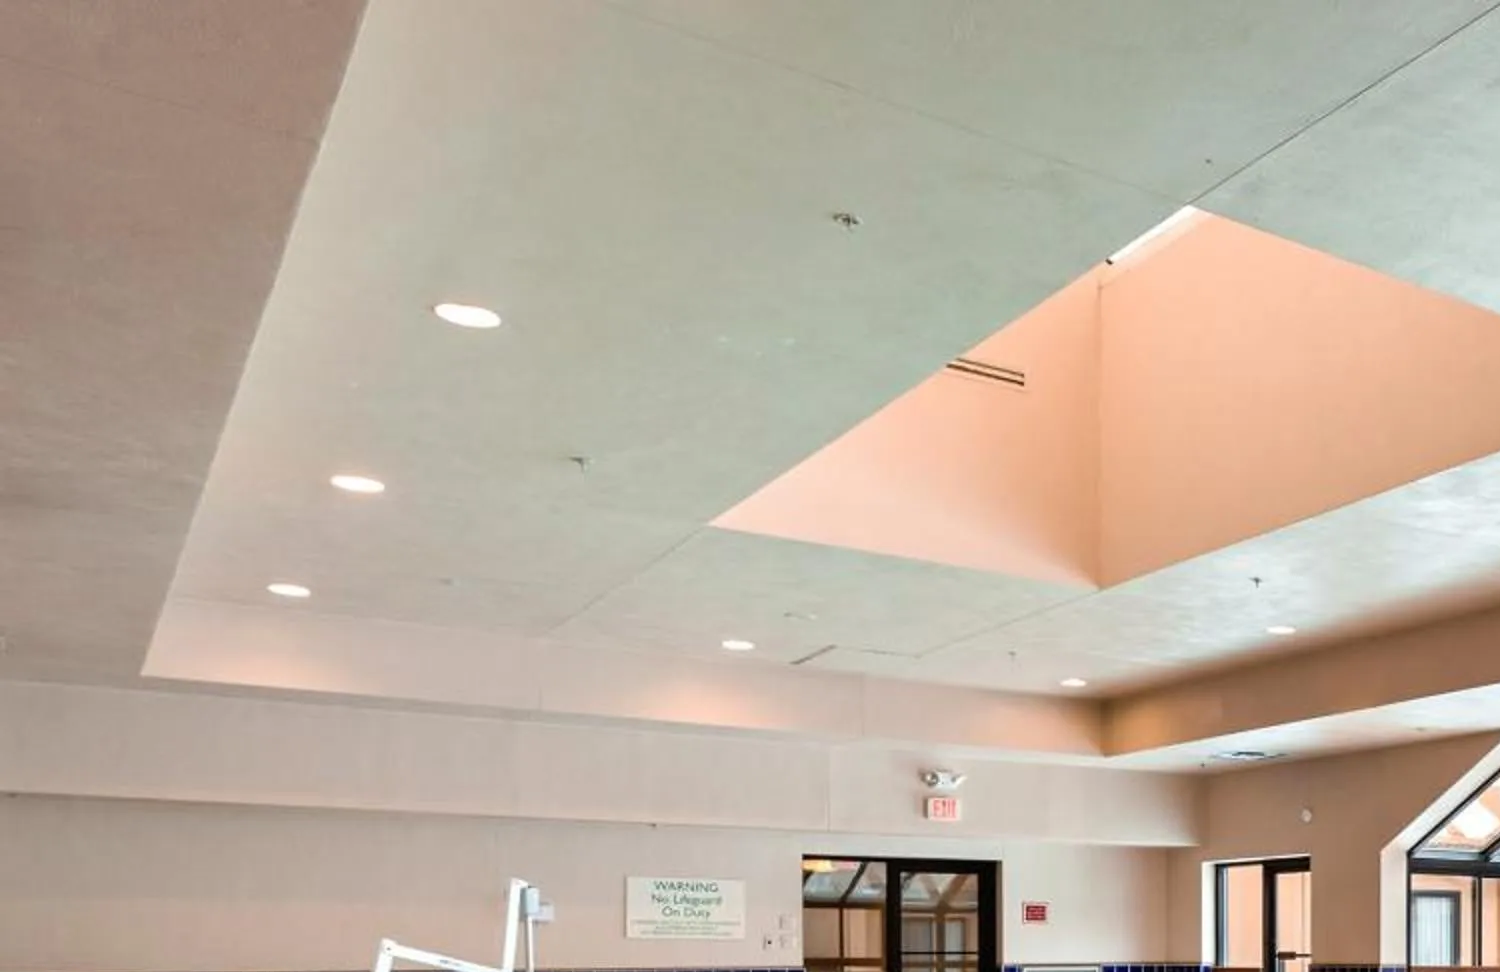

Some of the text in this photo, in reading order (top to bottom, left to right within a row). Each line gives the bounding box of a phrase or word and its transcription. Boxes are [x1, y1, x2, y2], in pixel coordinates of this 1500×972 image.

[933, 799, 956, 818] EXIT
[654, 880, 719, 893] WARNING
[651, 893, 723, 906] No Lifeguard
[661, 906, 711, 920] On Duty
